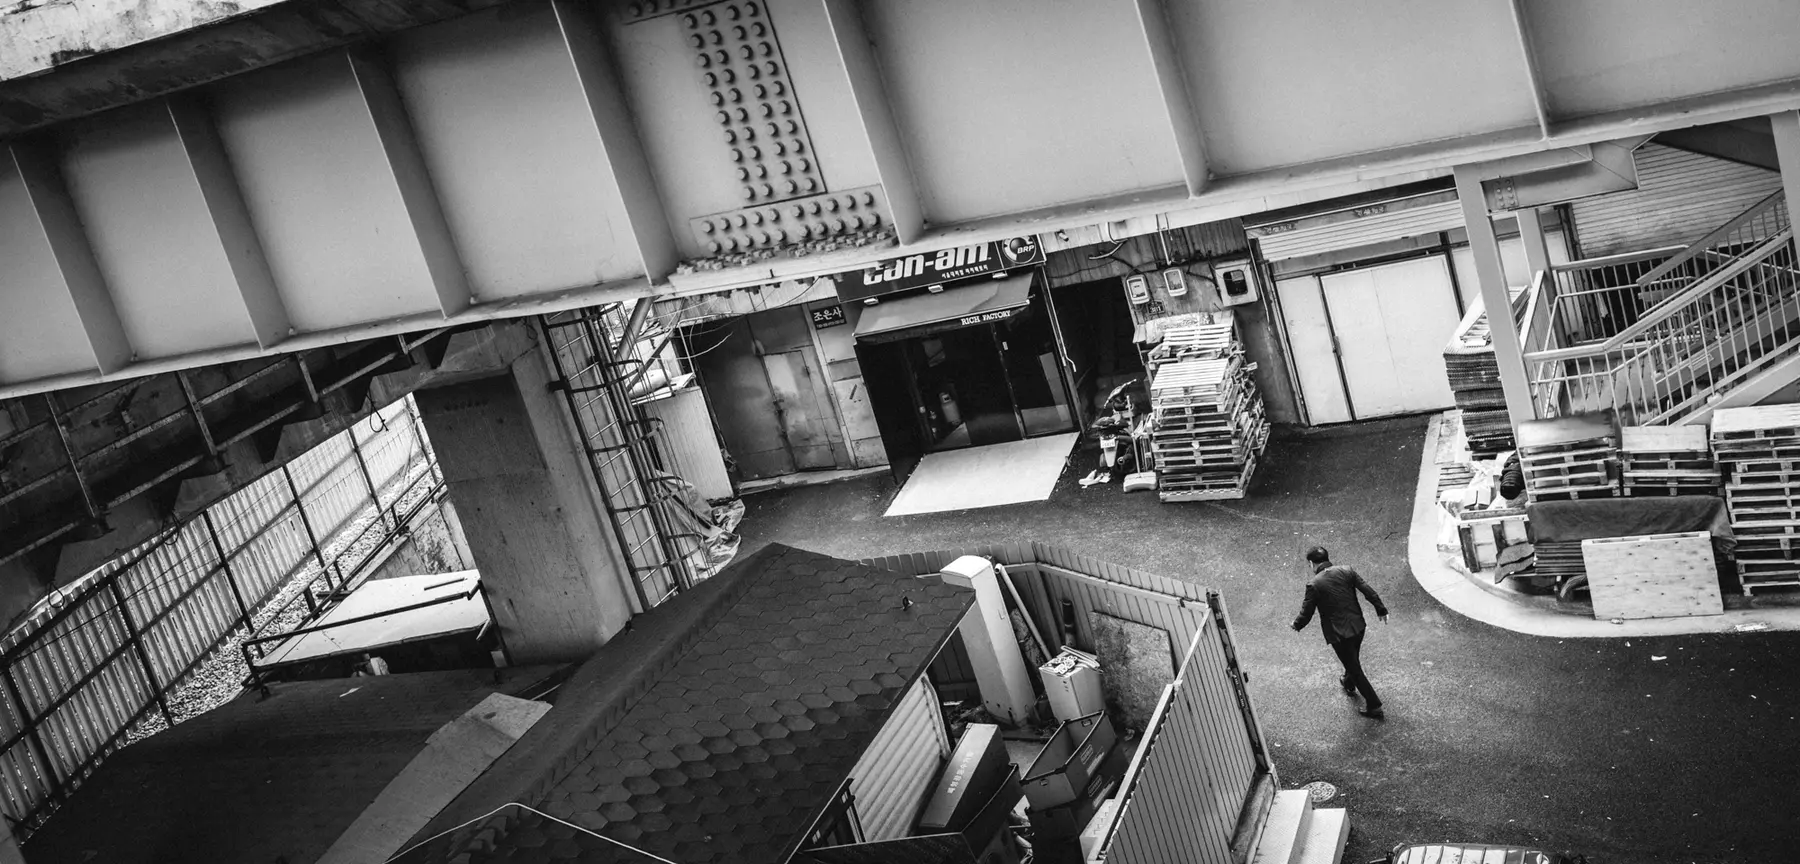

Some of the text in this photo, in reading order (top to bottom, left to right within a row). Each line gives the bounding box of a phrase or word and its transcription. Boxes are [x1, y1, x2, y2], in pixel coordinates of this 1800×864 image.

[1017, 244, 1035, 254] BRP
[813, 306, 842, 322] 조은사
[960, 310, 1011, 326] RICH FACTORY
